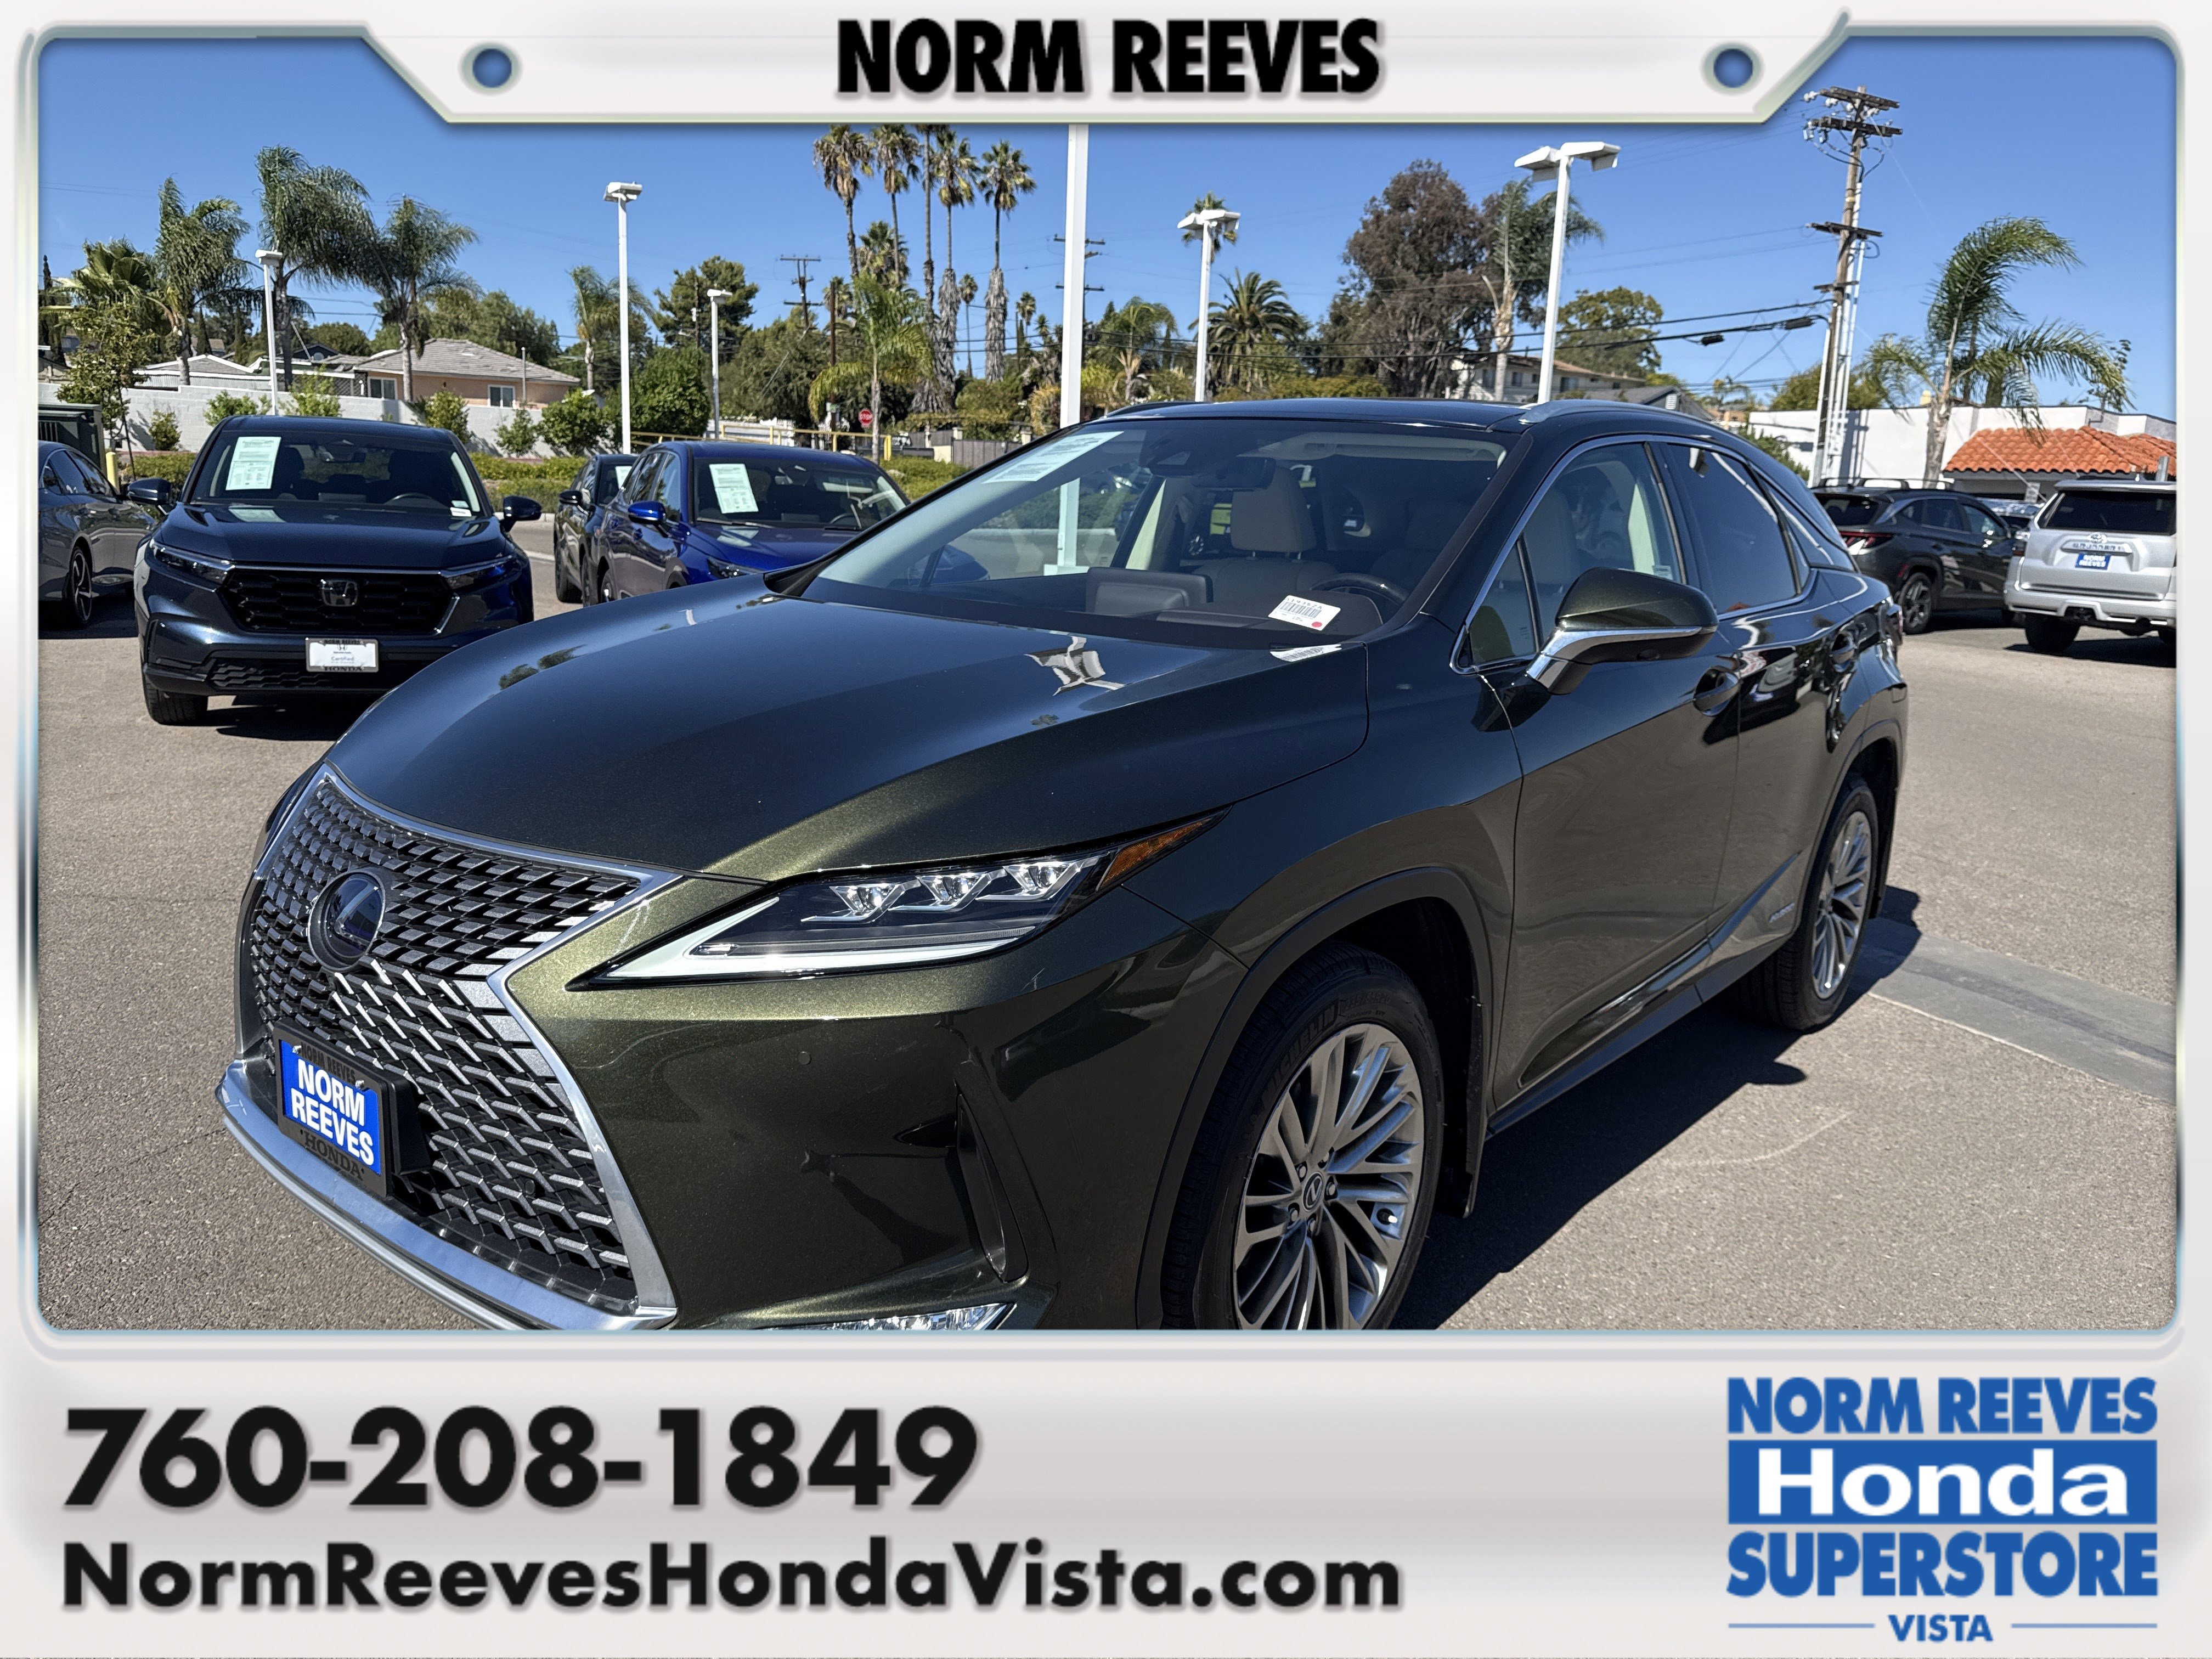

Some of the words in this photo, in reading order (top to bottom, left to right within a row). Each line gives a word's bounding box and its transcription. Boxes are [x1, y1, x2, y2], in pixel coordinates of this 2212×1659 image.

[301, 1042, 325, 1070] NORM
[328, 1055, 357, 1084] REEVES
[1261, 1003, 1336, 1109] MICHELIN
[298, 1058, 365, 1126] NORM
[291, 1087, 374, 1166] REEVES
[304, 1132, 364, 1180] HONDA
